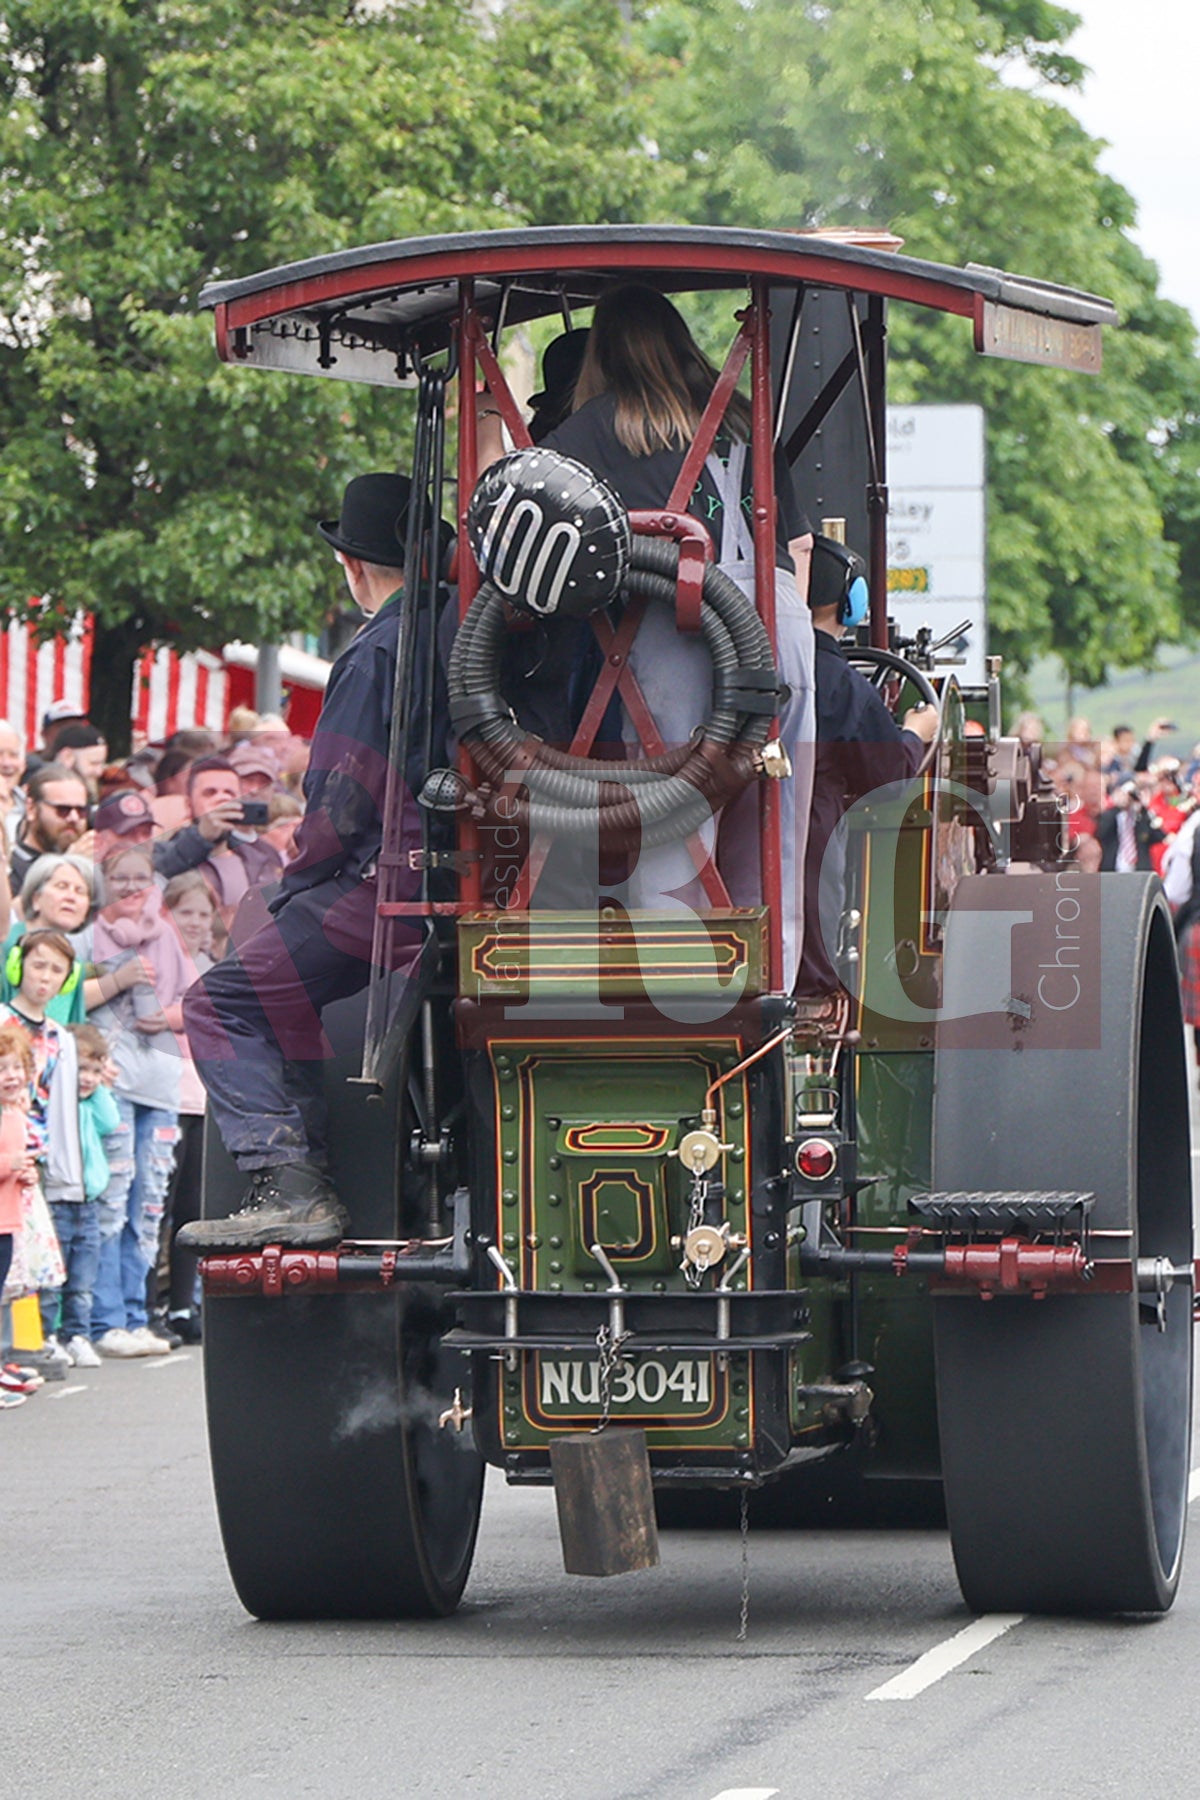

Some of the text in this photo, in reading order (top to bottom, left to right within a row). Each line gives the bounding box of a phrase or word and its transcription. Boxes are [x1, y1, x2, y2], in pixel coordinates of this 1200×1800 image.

[480, 483, 580, 613] 100
[541, 1361, 709, 1404] NU 3041
